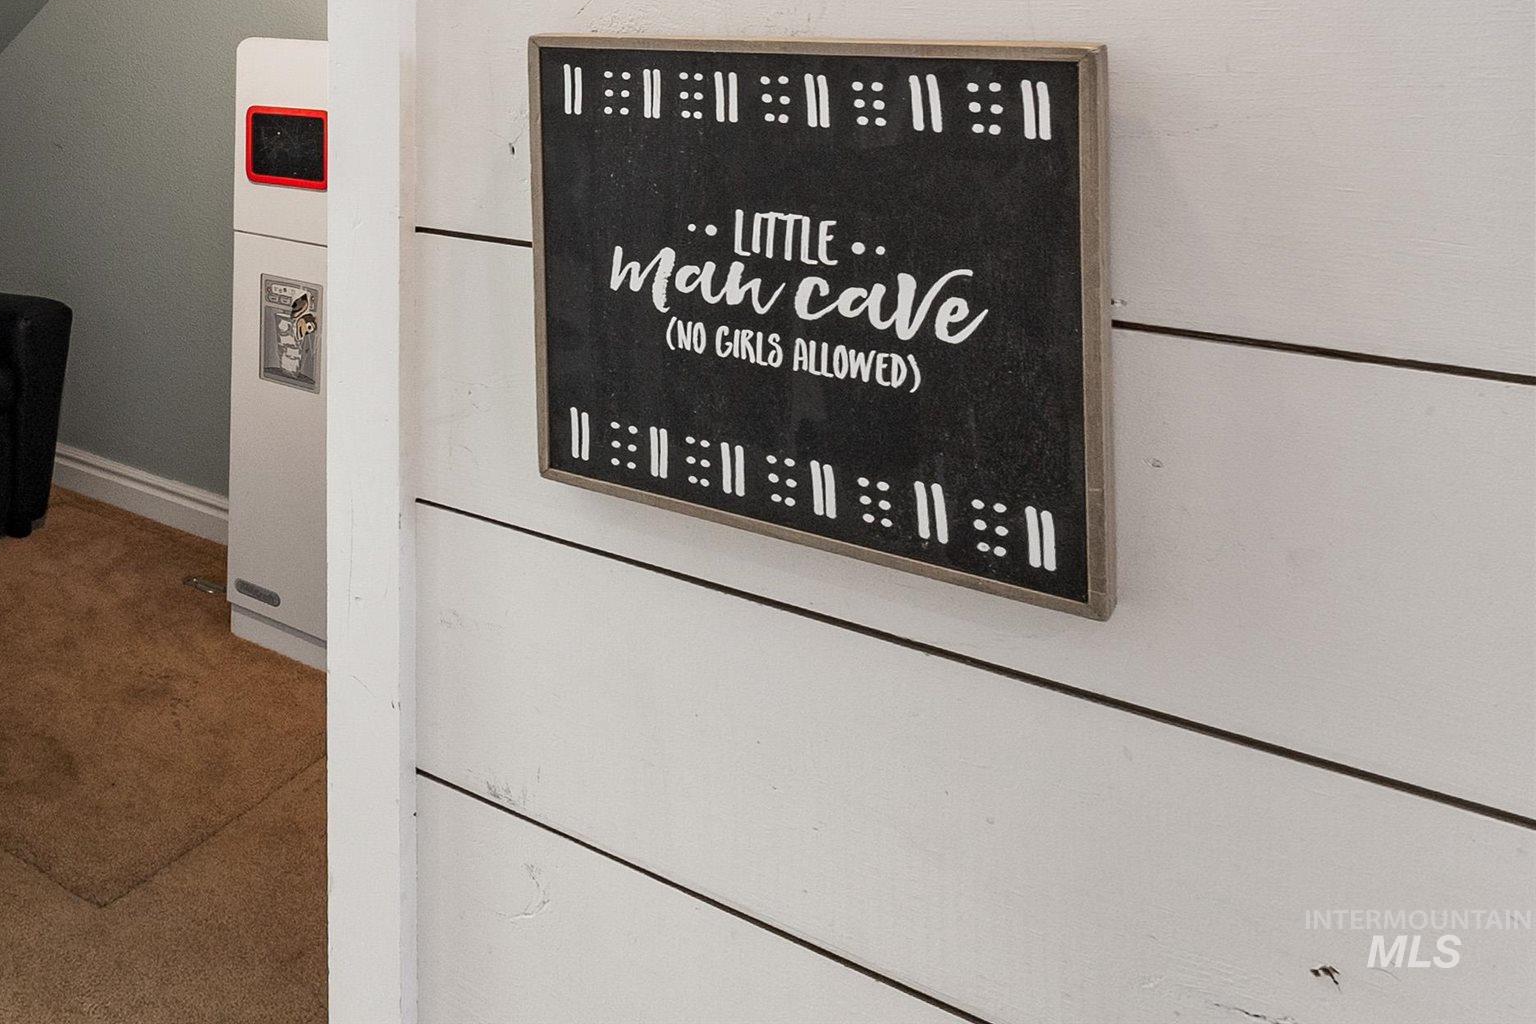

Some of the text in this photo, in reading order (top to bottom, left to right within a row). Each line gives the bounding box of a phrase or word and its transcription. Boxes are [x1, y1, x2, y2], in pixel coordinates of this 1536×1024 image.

[733, 208, 839, 266] LITTLE
[665, 315, 922, 394] (NO GIRLS ALLOWED)
